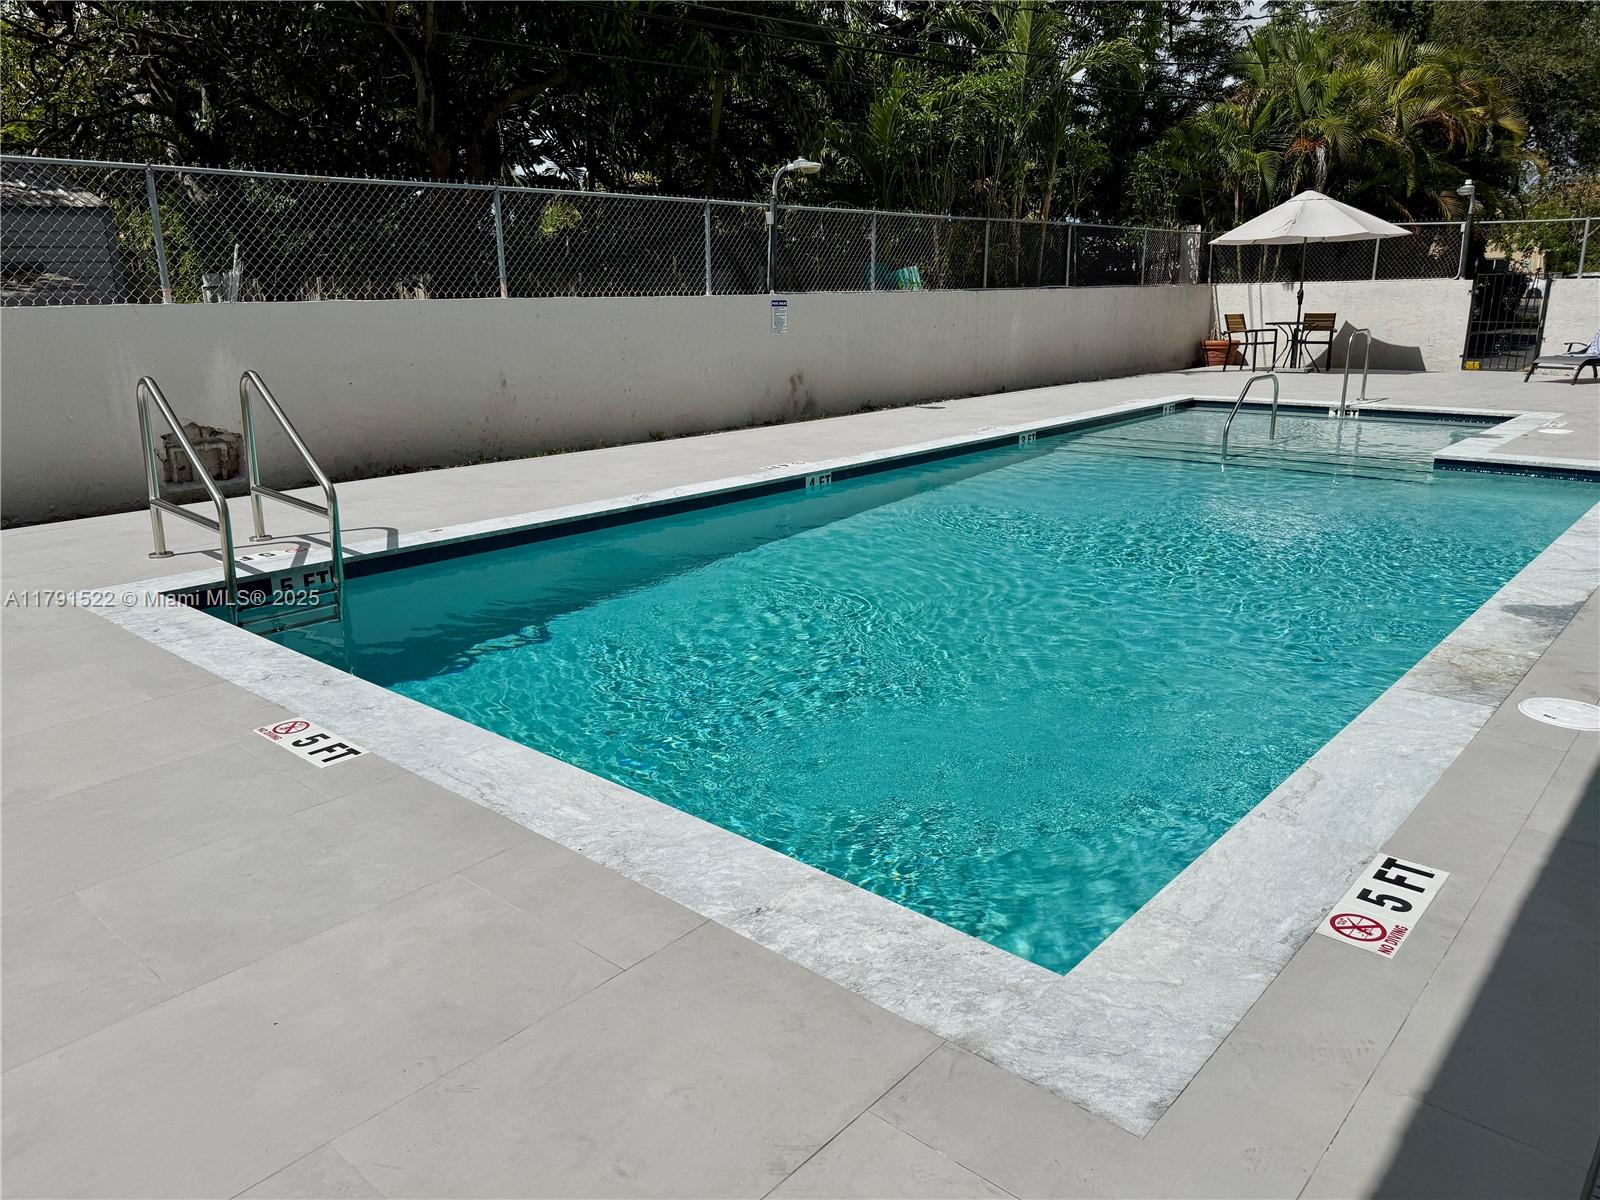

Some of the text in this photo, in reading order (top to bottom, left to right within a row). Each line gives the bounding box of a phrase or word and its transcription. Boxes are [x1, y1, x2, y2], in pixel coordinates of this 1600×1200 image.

[280, 570, 329, 592] 5 FT
[291, 733, 362, 763] 5 FT
[1356, 857, 1435, 913] 5 FT
[1377, 924, 1409, 956] NO DIVING
